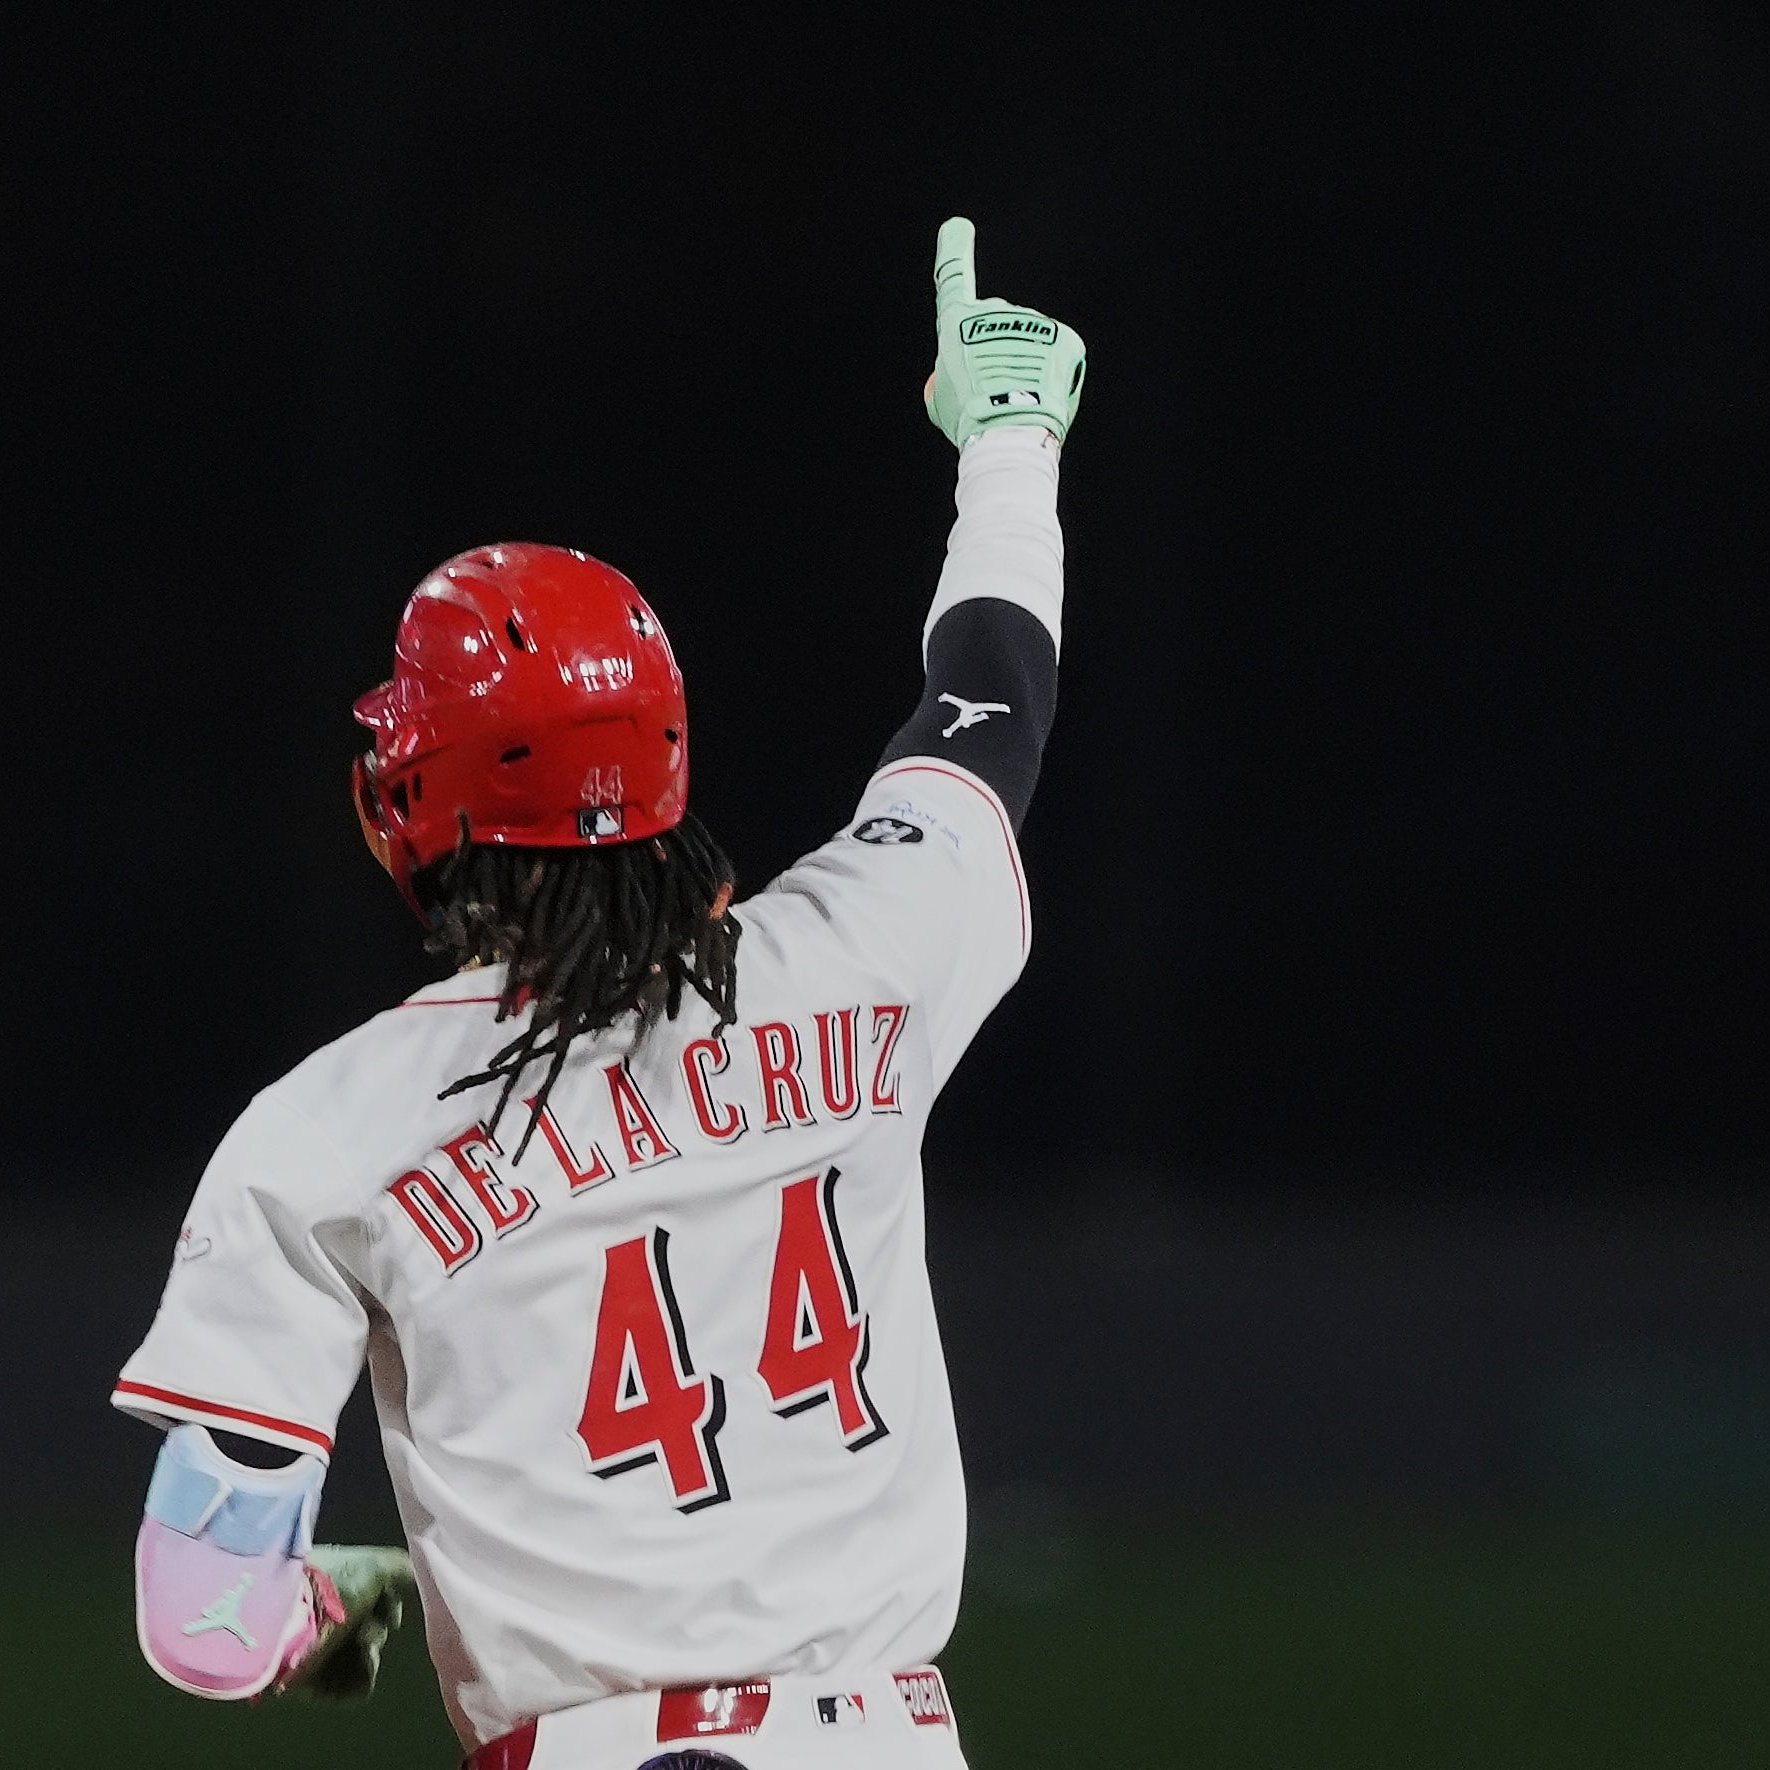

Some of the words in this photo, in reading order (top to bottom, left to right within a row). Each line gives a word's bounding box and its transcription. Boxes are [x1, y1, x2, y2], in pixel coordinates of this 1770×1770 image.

[580, 765, 624, 807] 44
[384, 1119, 540, 1278] DE
[523, 1055, 681, 1197] LA
[678, 1003, 910, 1145] CRUZ
[568, 1166, 890, 1515] 44
